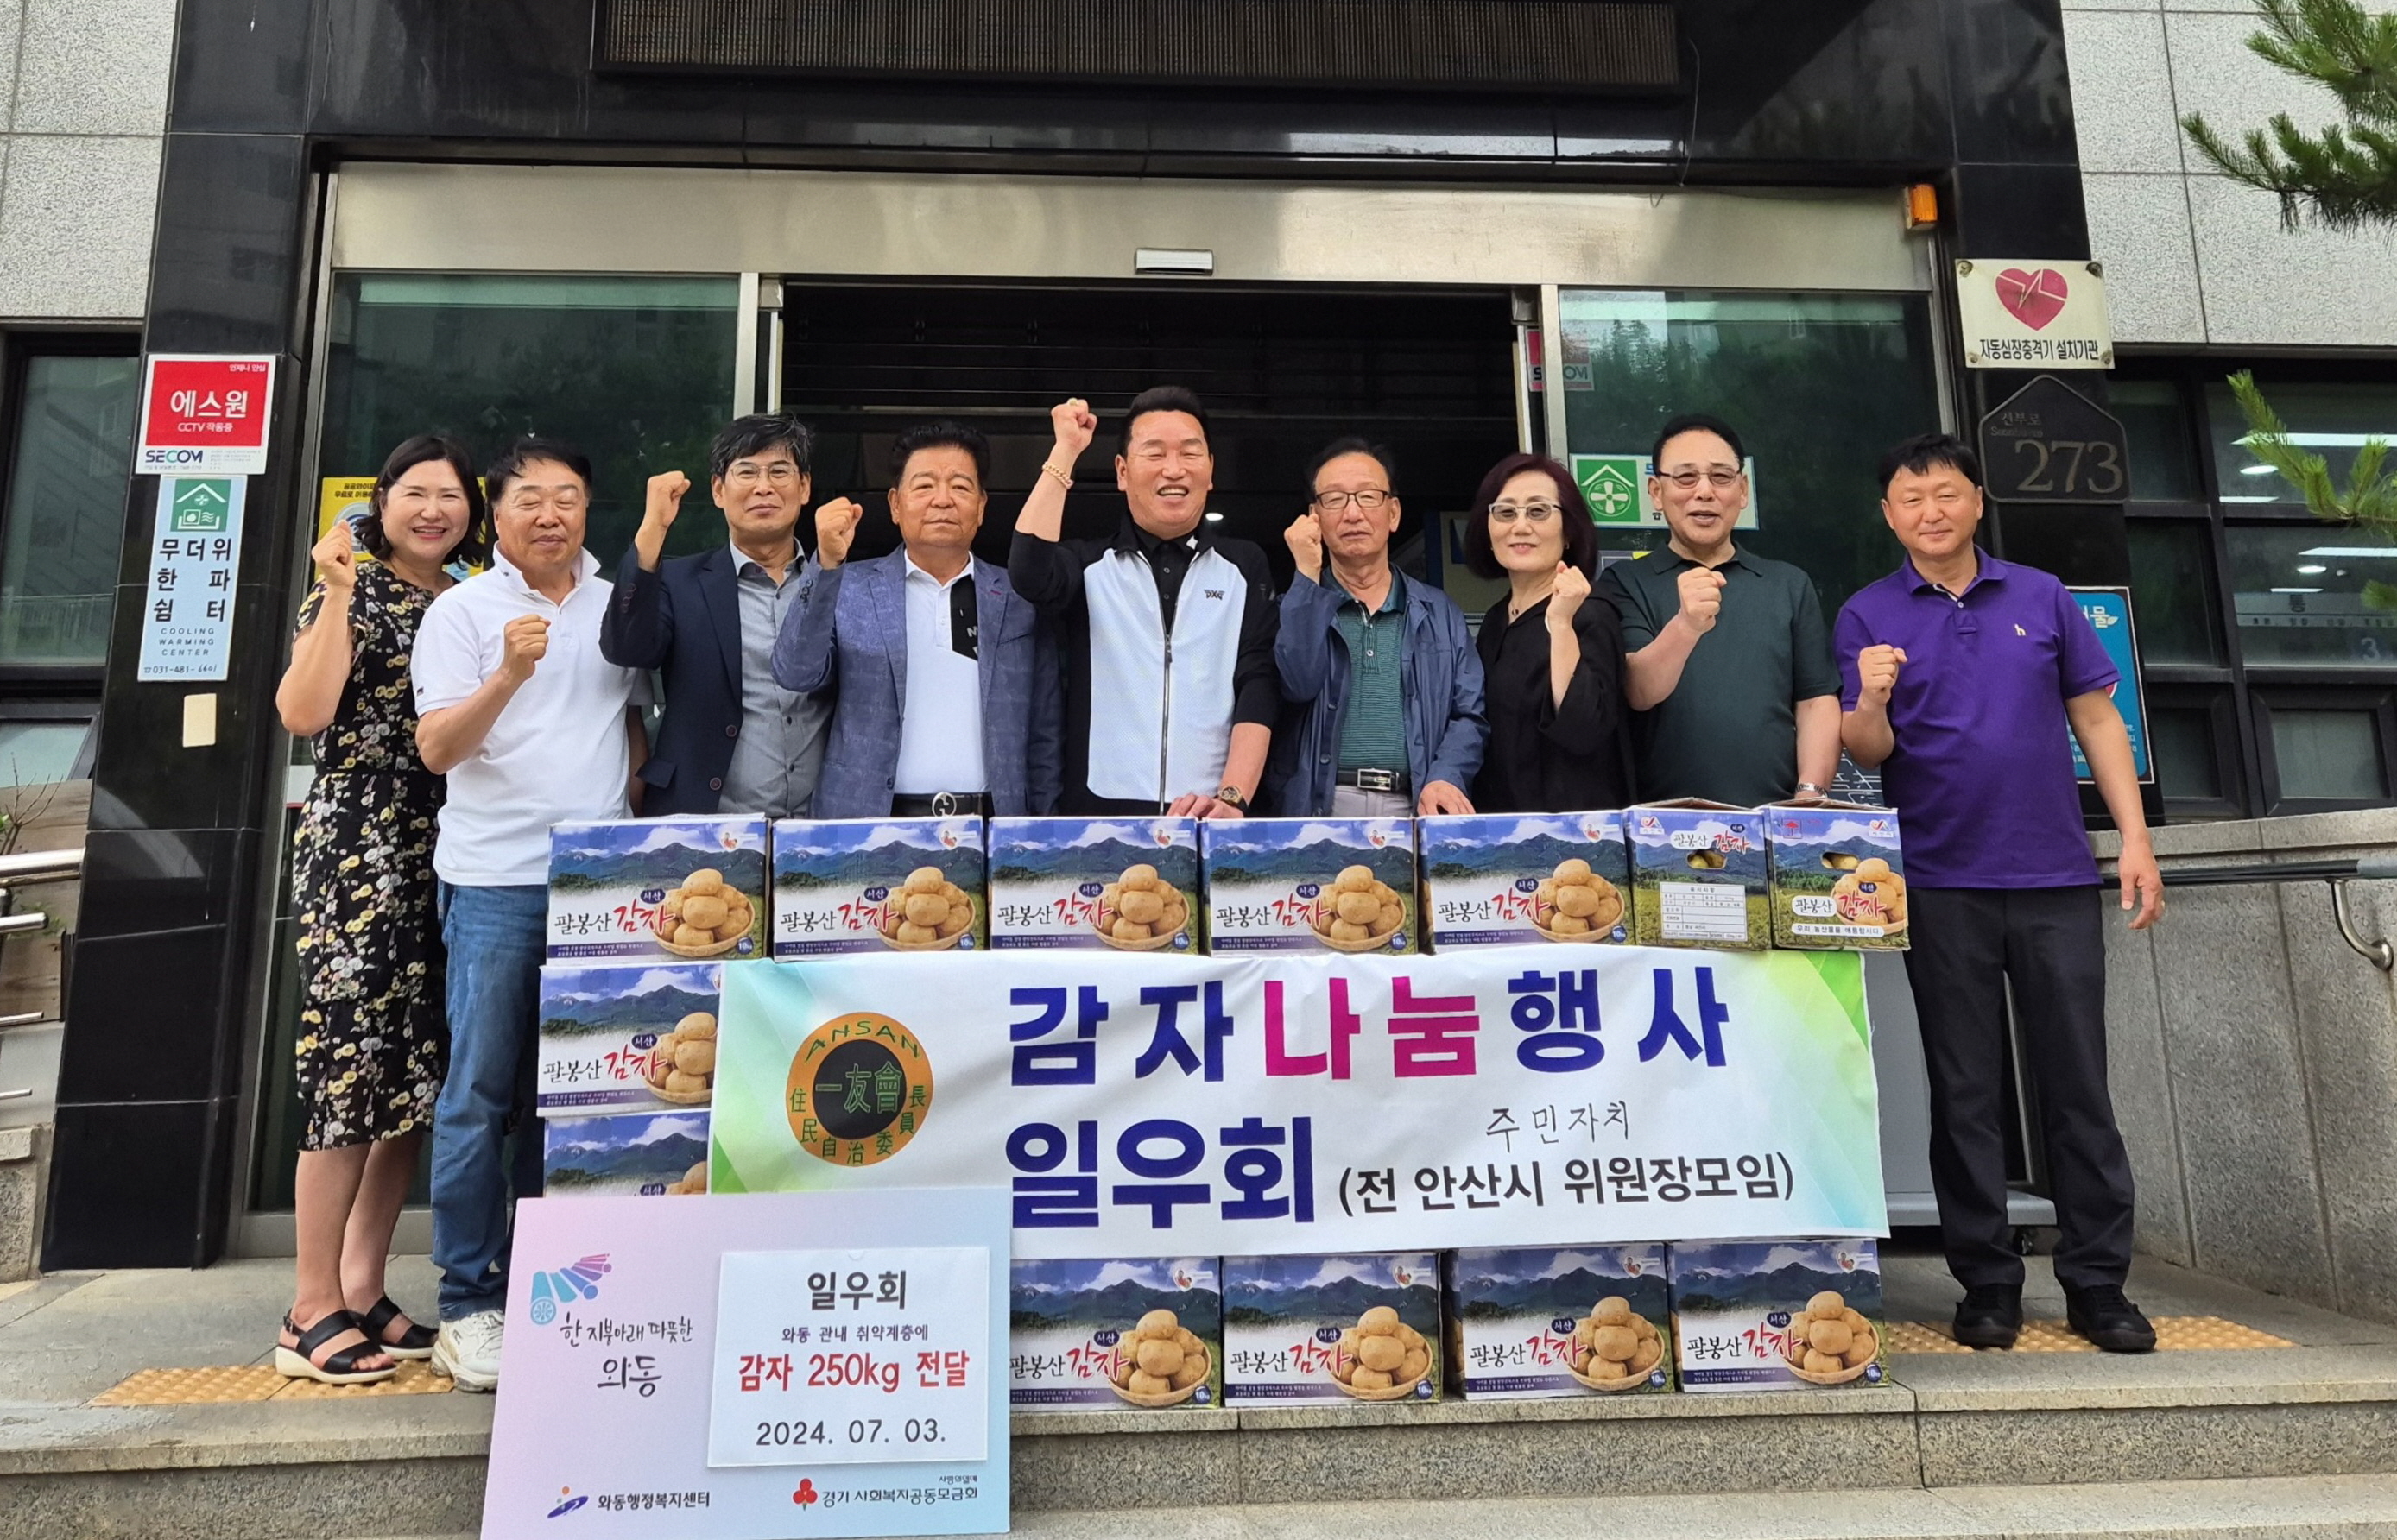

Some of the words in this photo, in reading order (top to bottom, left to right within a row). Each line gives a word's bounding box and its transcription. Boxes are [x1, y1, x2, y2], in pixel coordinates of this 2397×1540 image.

[1979, 339, 2054, 360] 자동심장충격기
[2056, 339, 2099, 360] 설치기관
[170, 390, 249, 418] 에스원
[178, 422, 206, 432] CCTV
[206, 422, 233, 432] 작동중
[145, 450, 203, 464] SECOM
[2014, 439, 2123, 494] 273
[160, 538, 232, 561] 무더위
[642, 891, 663, 903] 서산
[866, 888, 887, 900] 서산
[1081, 885, 1101, 896] 서산
[1298, 886, 1318, 897] 서산
[1517, 880, 1537, 892] 서산
[554, 913, 612, 935] 팔봉산
[613, 899, 676, 936] 감자
[781, 911, 837, 933] 팔봉산
[838, 896, 900, 932] 감자
[997, 905, 1053, 927] 팔봉산
[1053, 891, 1114, 928] 감자
[1216, 906, 1271, 928] 팔봉산
[1271, 893, 1331, 929] 감자
[1438, 901, 1492, 923] 팔봉산
[1491, 887, 1552, 923] 감자
[1838, 889, 1886, 918] 감자
[634, 1037, 655, 1047] 서산
[805, 1020, 920, 1063] ANSAN
[543, 1059, 603, 1083] 팔봉산
[604, 1044, 667, 1082] 감자
[815, 1060, 902, 1114] 一友會
[1485, 1100, 1630, 1153] 주민자치
[1004, 1115, 1315, 1229] 일우회
[1338, 1166, 1398, 1217] (전
[1413, 1160, 1545, 1210] 안산시
[1564, 1151, 1793, 1204] 위원장모임)
[806, 1270, 907, 1310] 일우회
[560, 1311, 583, 1348] 한
[586, 1317, 644, 1346] 지붕아래
[648, 1316, 693, 1343] 따뜻한
[781, 1326, 810, 1343] 와동
[819, 1325, 847, 1342] 관내
[856, 1323, 929, 1341] 취약계층에
[1554, 1320, 1572, 1331] 서산
[1769, 1314, 1788, 1326] 서산
[1097, 1333, 1116, 1344] 서산
[1319, 1329, 1338, 1341] 서산
[1470, 1343, 1527, 1368] 팔봉산
[1526, 1328, 1588, 1367] 감자
[1687, 1336, 1742, 1360] 팔봉산
[1742, 1321, 1803, 1361] 감자
[1009, 1354, 1066, 1379] 팔봉산
[1066, 1340, 1130, 1381] 감자
[1230, 1350, 1289, 1374] 팔봉산
[1289, 1336, 1353, 1376] 감자
[738, 1353, 793, 1392] 감자
[807, 1352, 900, 1393] 250kg
[915, 1349, 970, 1387] 전달
[756, 1420, 833, 1446] 2024.
[848, 1419, 889, 1443] 07.
[905, 1417, 946, 1442] 03.
[598, 1491, 710, 1511] 와동행정복지센터
[822, 1491, 849, 1508] 경기
[854, 1487, 978, 1505] 사회복지공동모금회
